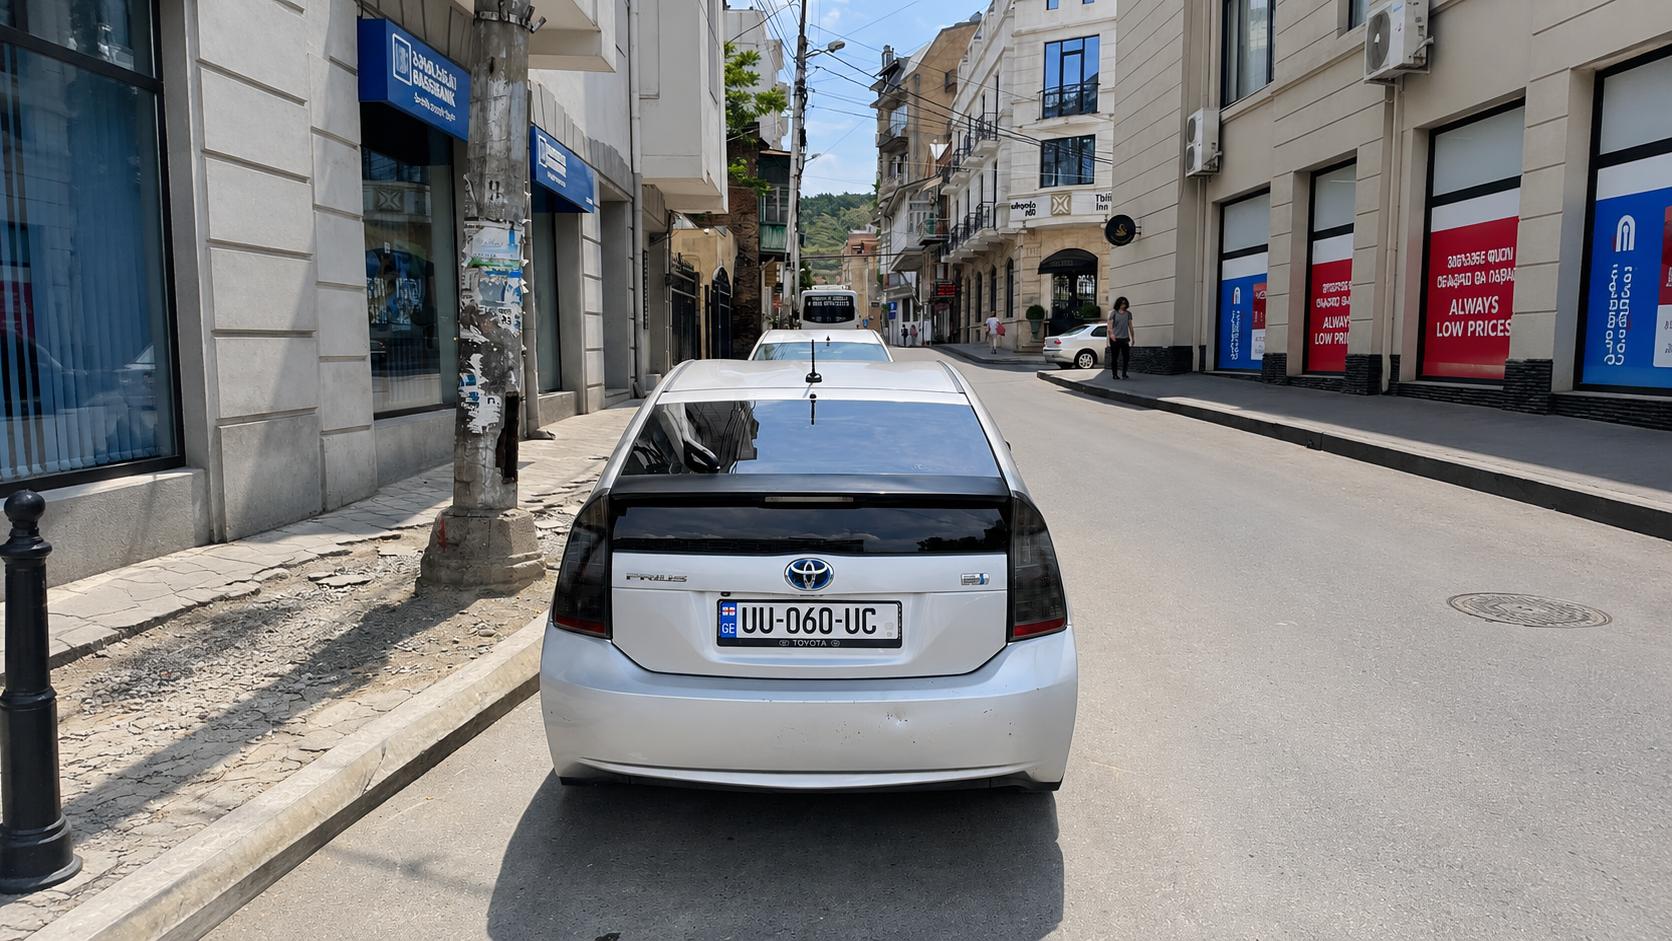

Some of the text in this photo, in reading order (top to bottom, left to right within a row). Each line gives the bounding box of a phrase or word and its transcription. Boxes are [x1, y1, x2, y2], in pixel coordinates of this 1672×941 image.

[1096, 203, 1109, 211] Inn
[1449, 296, 1499, 316] ALWAYS
[1322, 315, 1350, 329] ALWAY
[1436, 319, 1512, 337] LOW PRICES
[1314, 332, 1333, 345] LOW
[742, 607, 877, 634] UU-060-UC
[721, 623, 736, 634] GE
